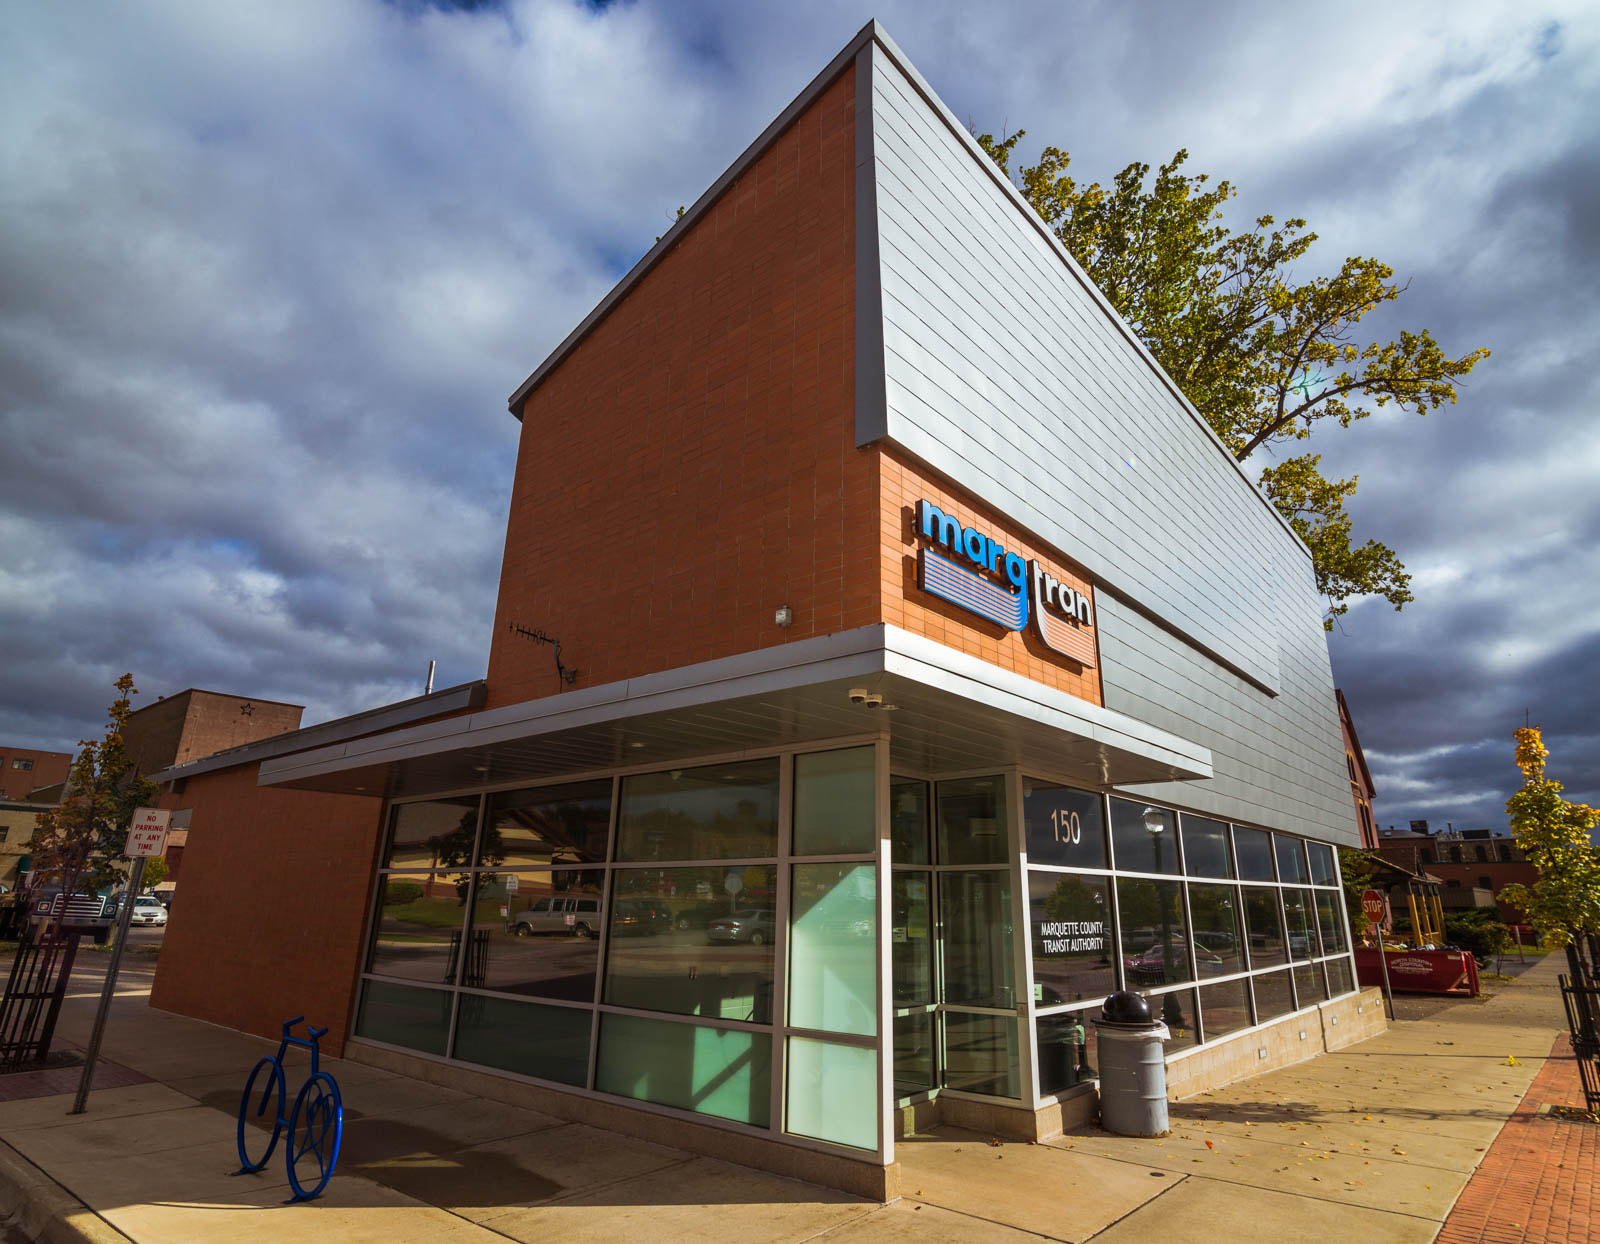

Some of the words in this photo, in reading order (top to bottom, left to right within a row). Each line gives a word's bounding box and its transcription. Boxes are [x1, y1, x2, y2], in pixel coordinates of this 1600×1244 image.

[135, 824, 164, 832] PARKING
[1051, 808, 1081, 845] 150
[137, 843, 153, 851] TIME
[1363, 900, 1382, 913] STOP
[1041, 922, 1079, 937] MARQUETTE
[1080, 921, 1103, 935] COUNTY
[1043, 938, 1070, 953] TRANSIT
[1071, 937, 1103, 951] AUTHORITY
